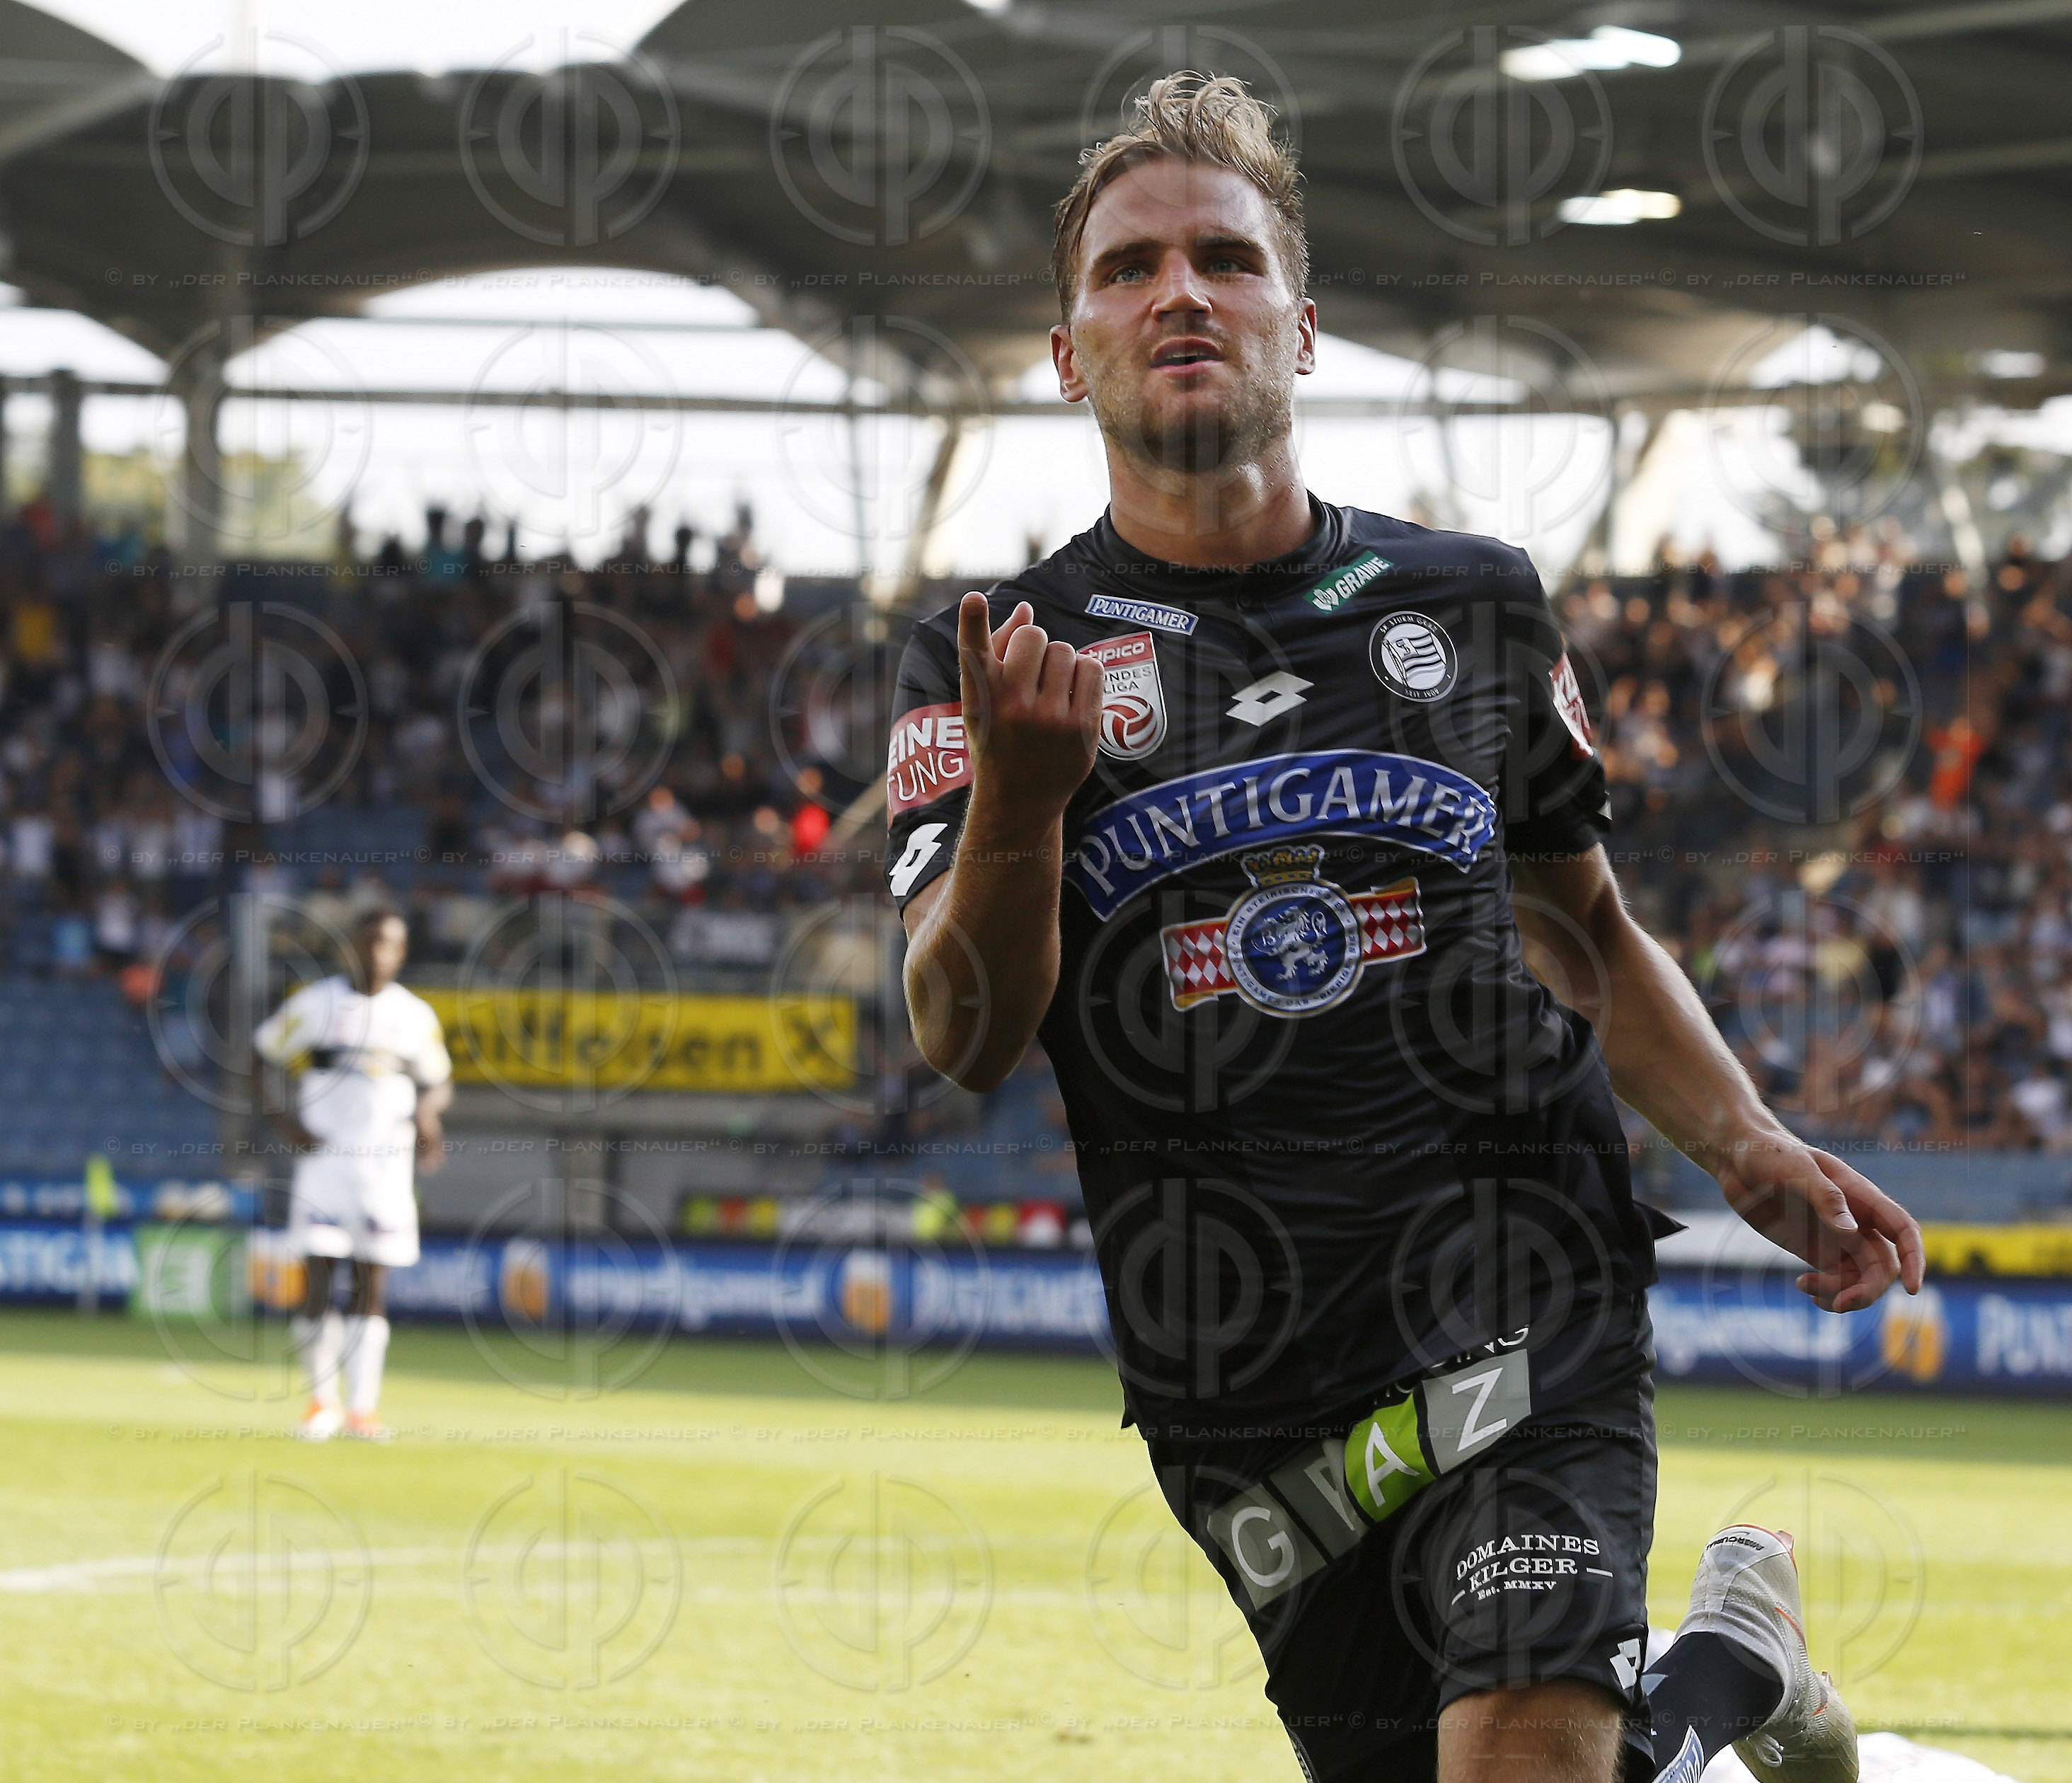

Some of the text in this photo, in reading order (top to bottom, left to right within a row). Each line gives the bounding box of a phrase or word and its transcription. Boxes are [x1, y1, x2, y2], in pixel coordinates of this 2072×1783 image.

[1335, 556, 1390, 599] GRAWE
[1092, 597, 1190, 630] PUNTIGAMER
[887, 715, 965, 773] EINE
[887, 751, 965, 810] TUNG
[1078, 766, 1496, 897] PUNTIGAMER
[1456, 1534, 1600, 1580] DOMAINES
[1469, 1557, 1578, 1593] KILGER
[1477, 1581, 1557, 1600] Est. MMXV
